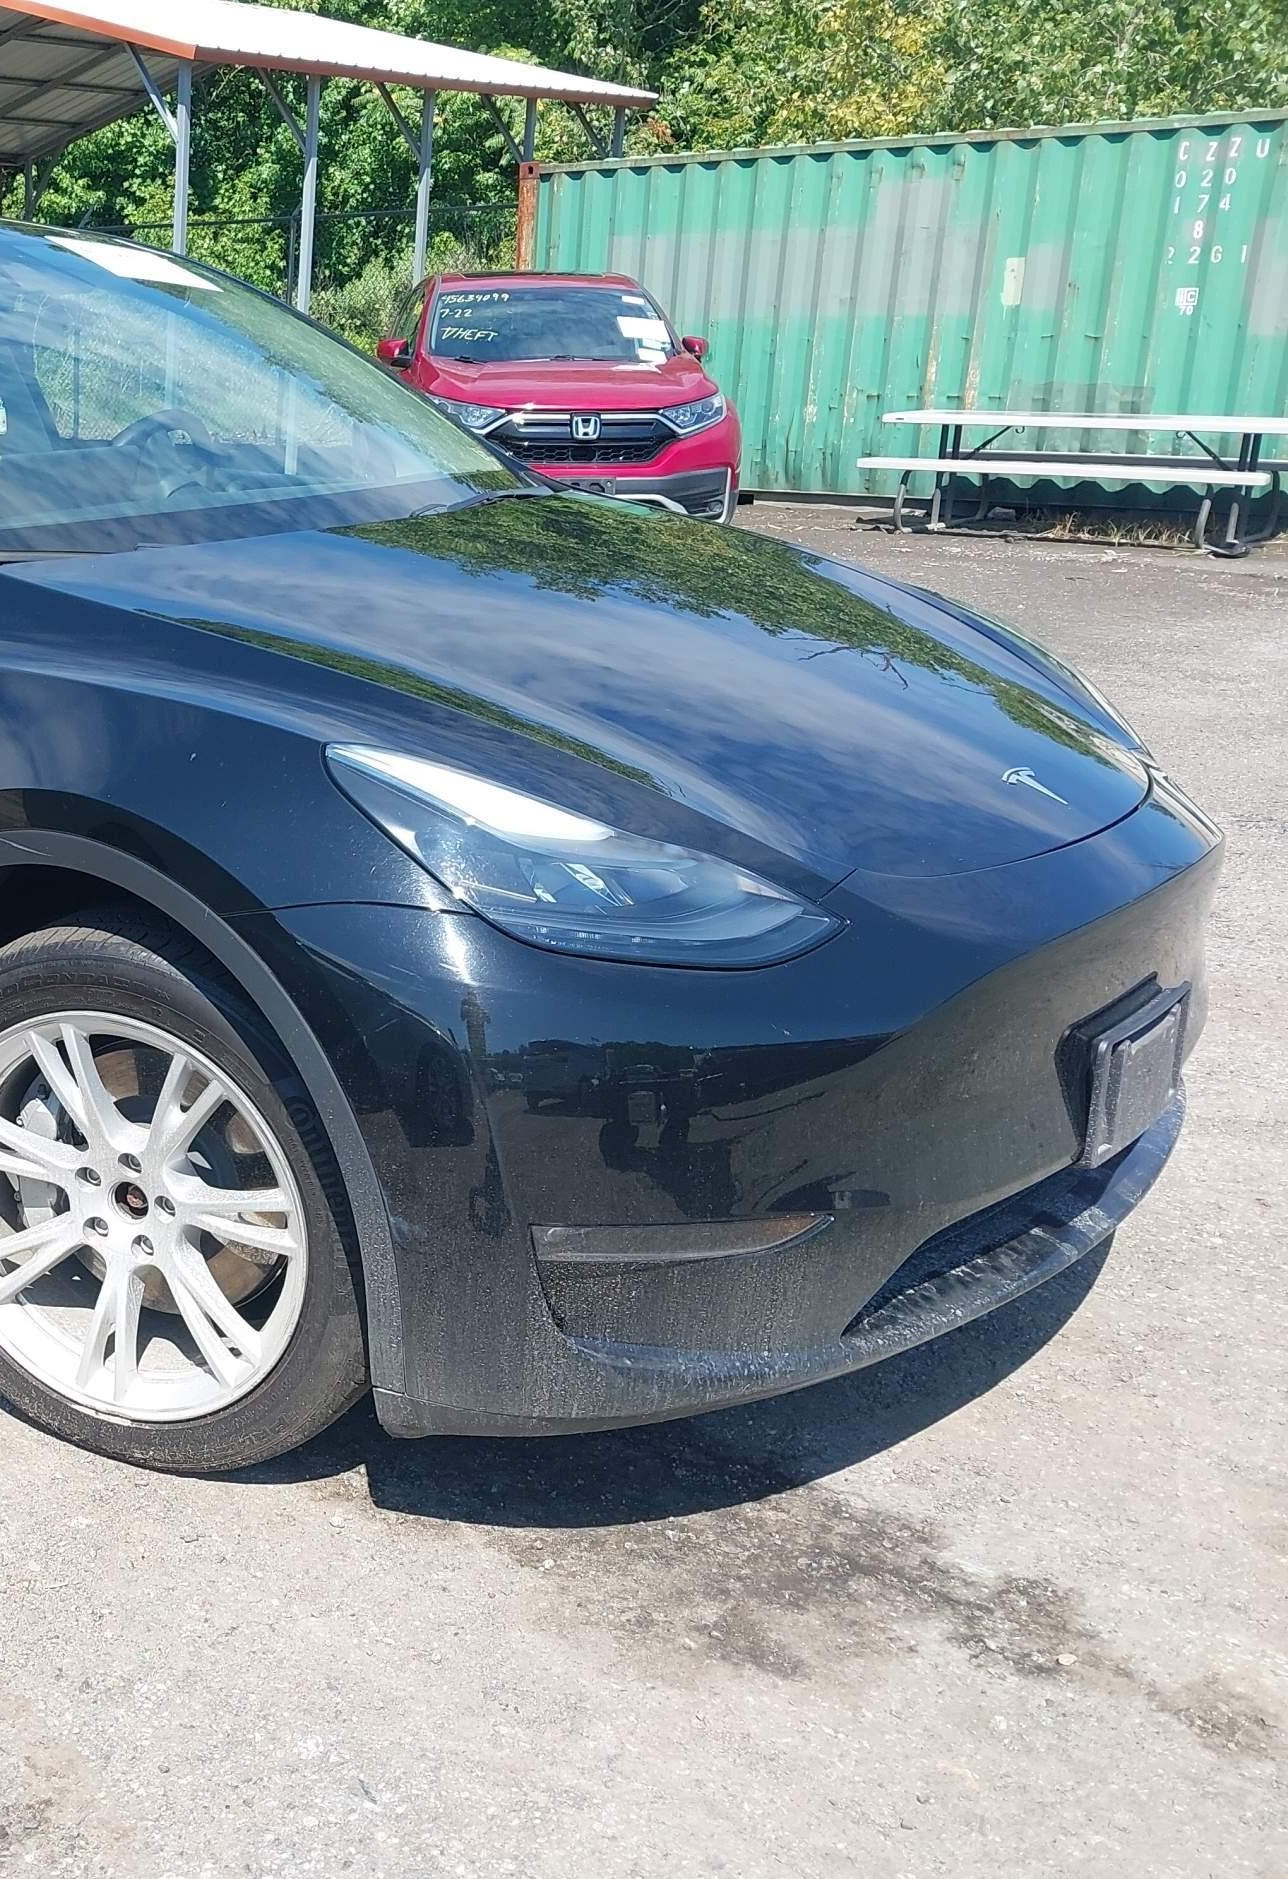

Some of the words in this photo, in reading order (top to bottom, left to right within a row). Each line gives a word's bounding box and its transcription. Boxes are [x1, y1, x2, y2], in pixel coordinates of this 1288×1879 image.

[1193, 220, 1204, 239] 8
[440, 308, 472, 318] 7-22
[440, 326, 499, 342] THEFT
